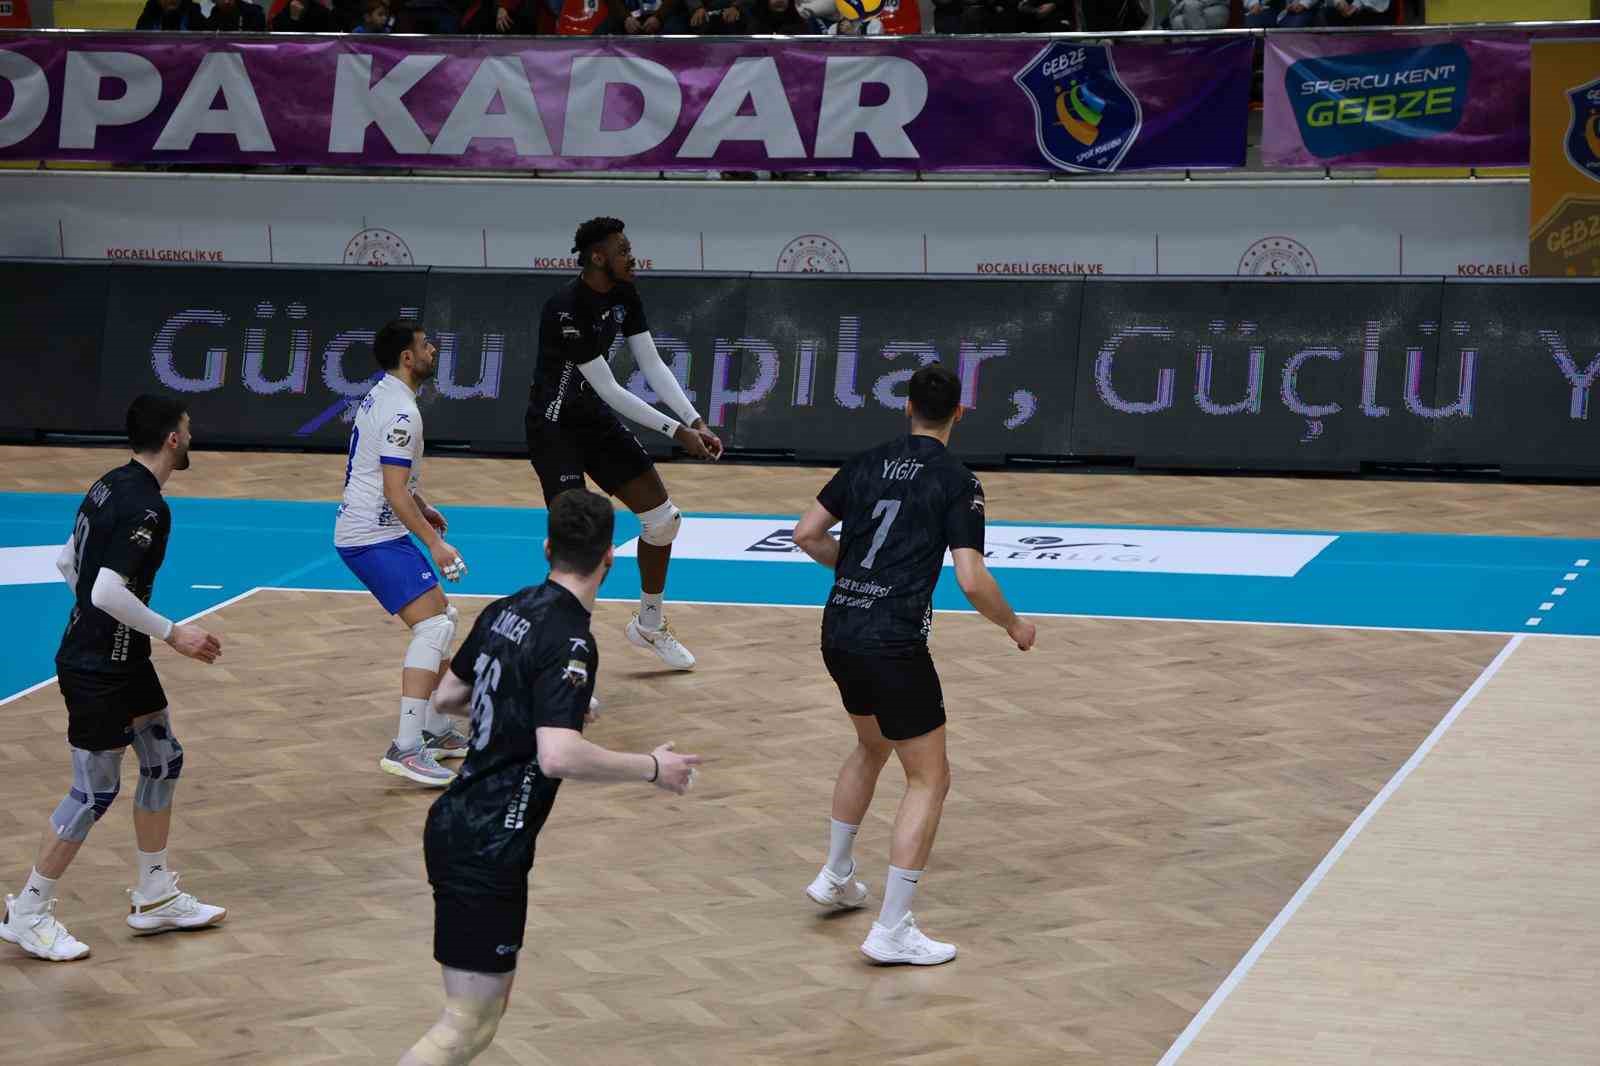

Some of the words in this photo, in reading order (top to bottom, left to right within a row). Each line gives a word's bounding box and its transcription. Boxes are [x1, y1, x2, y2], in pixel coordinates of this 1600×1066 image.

[1042, 47, 1087, 76] GEBZE
[1300, 74, 1390, 95] SPORCU
[1394, 65, 1456, 86] KENT
[328, 53, 929, 159] KADAR
[1306, 86, 1457, 127] GEBZE
[209, 250, 224, 261] VE
[1088, 263, 1104, 273] VE
[1095, 319, 1481, 442] Güçlü
[860, 499, 902, 570] 7
[471, 652, 502, 751] 16
